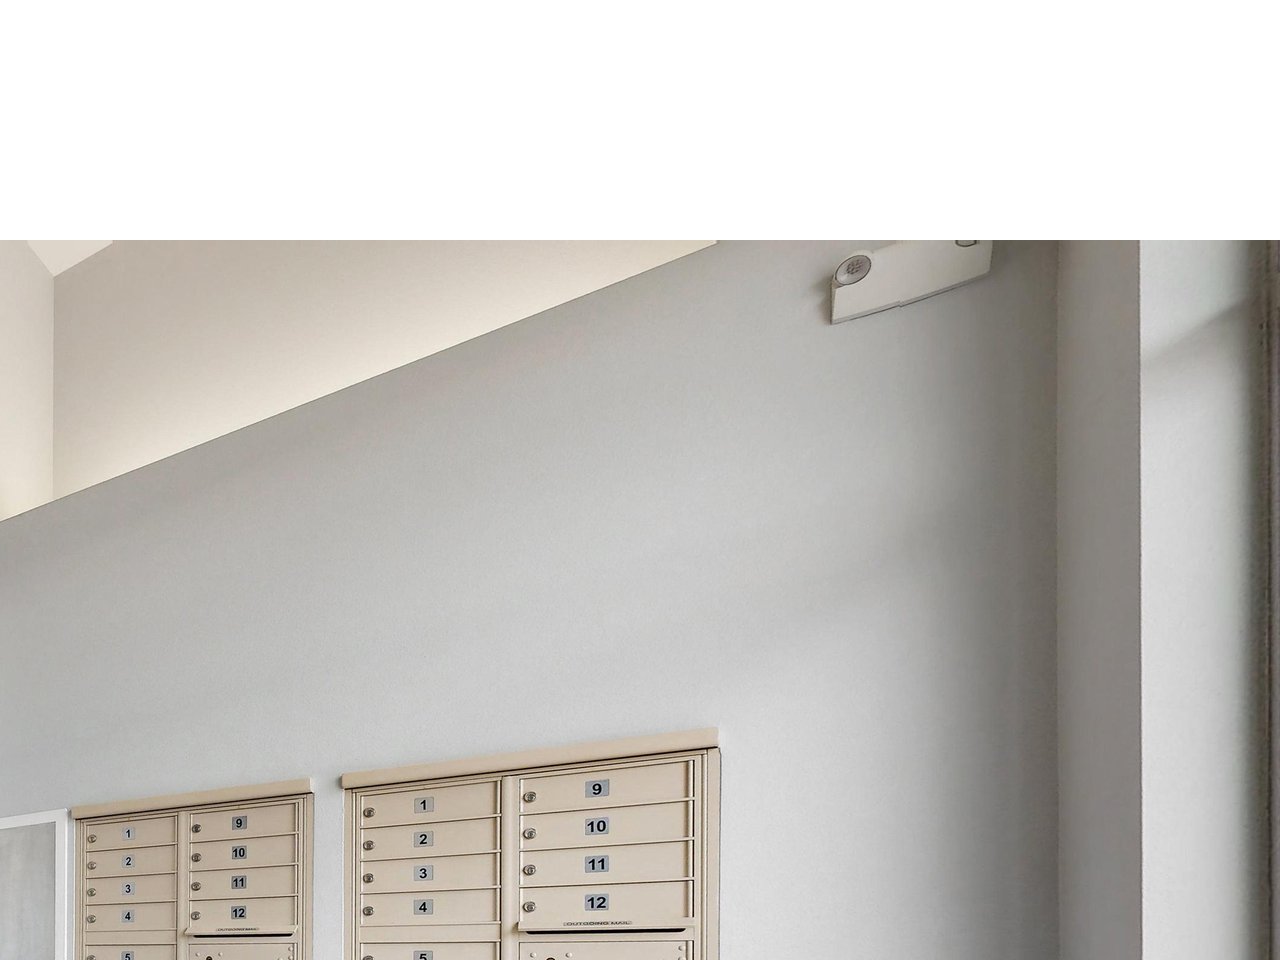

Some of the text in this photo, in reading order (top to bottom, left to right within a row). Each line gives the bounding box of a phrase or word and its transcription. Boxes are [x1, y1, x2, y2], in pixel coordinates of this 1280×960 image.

[592, 783, 602, 795] 9
[420, 799, 426, 810] 1
[236, 818, 243, 828] 9
[587, 820, 607, 832] 10
[126, 829, 131, 838] 1
[419, 833, 427, 845] 2
[232, 847, 245, 858] 10
[125, 857, 131, 866] 2
[588, 857, 605, 871] 11
[419, 867, 427, 879] 3
[233, 877, 244, 888] 11
[125, 884, 131, 893] 3
[418, 901, 427, 912] 4
[587, 896, 607, 909] 12
[125, 912, 131, 921] 4
[232, 908, 245, 918] 12
